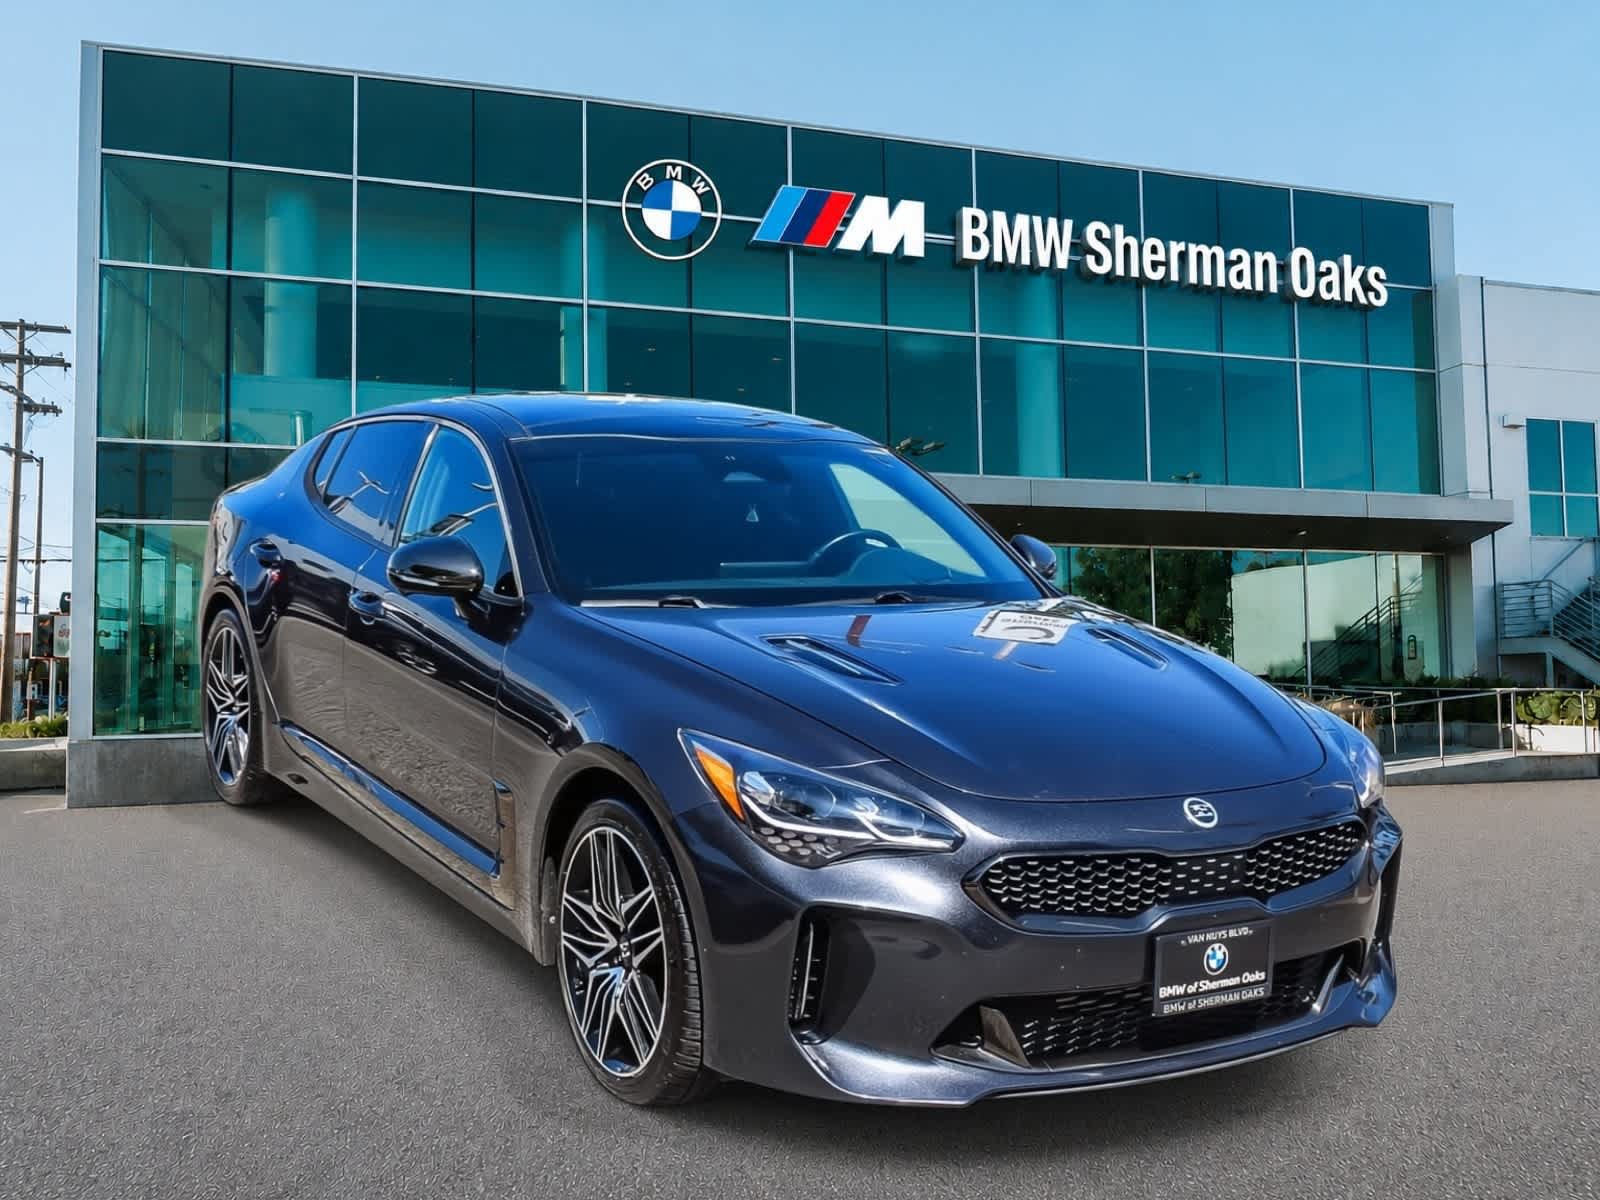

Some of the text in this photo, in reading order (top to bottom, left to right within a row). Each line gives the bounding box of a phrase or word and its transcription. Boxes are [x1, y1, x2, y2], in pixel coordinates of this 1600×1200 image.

[626, 165, 711, 195] BMW
[960, 206, 1388, 307] BMW Sherman Oaks
[1187, 934, 1205, 944] VAN
[1159, 970, 1266, 998] BMW of Sherman Oaks
[1163, 1002, 1186, 1014] BMW
[1198, 992, 1240, 1008] SHERMAN
[1241, 987, 1265, 1000] OAKS
